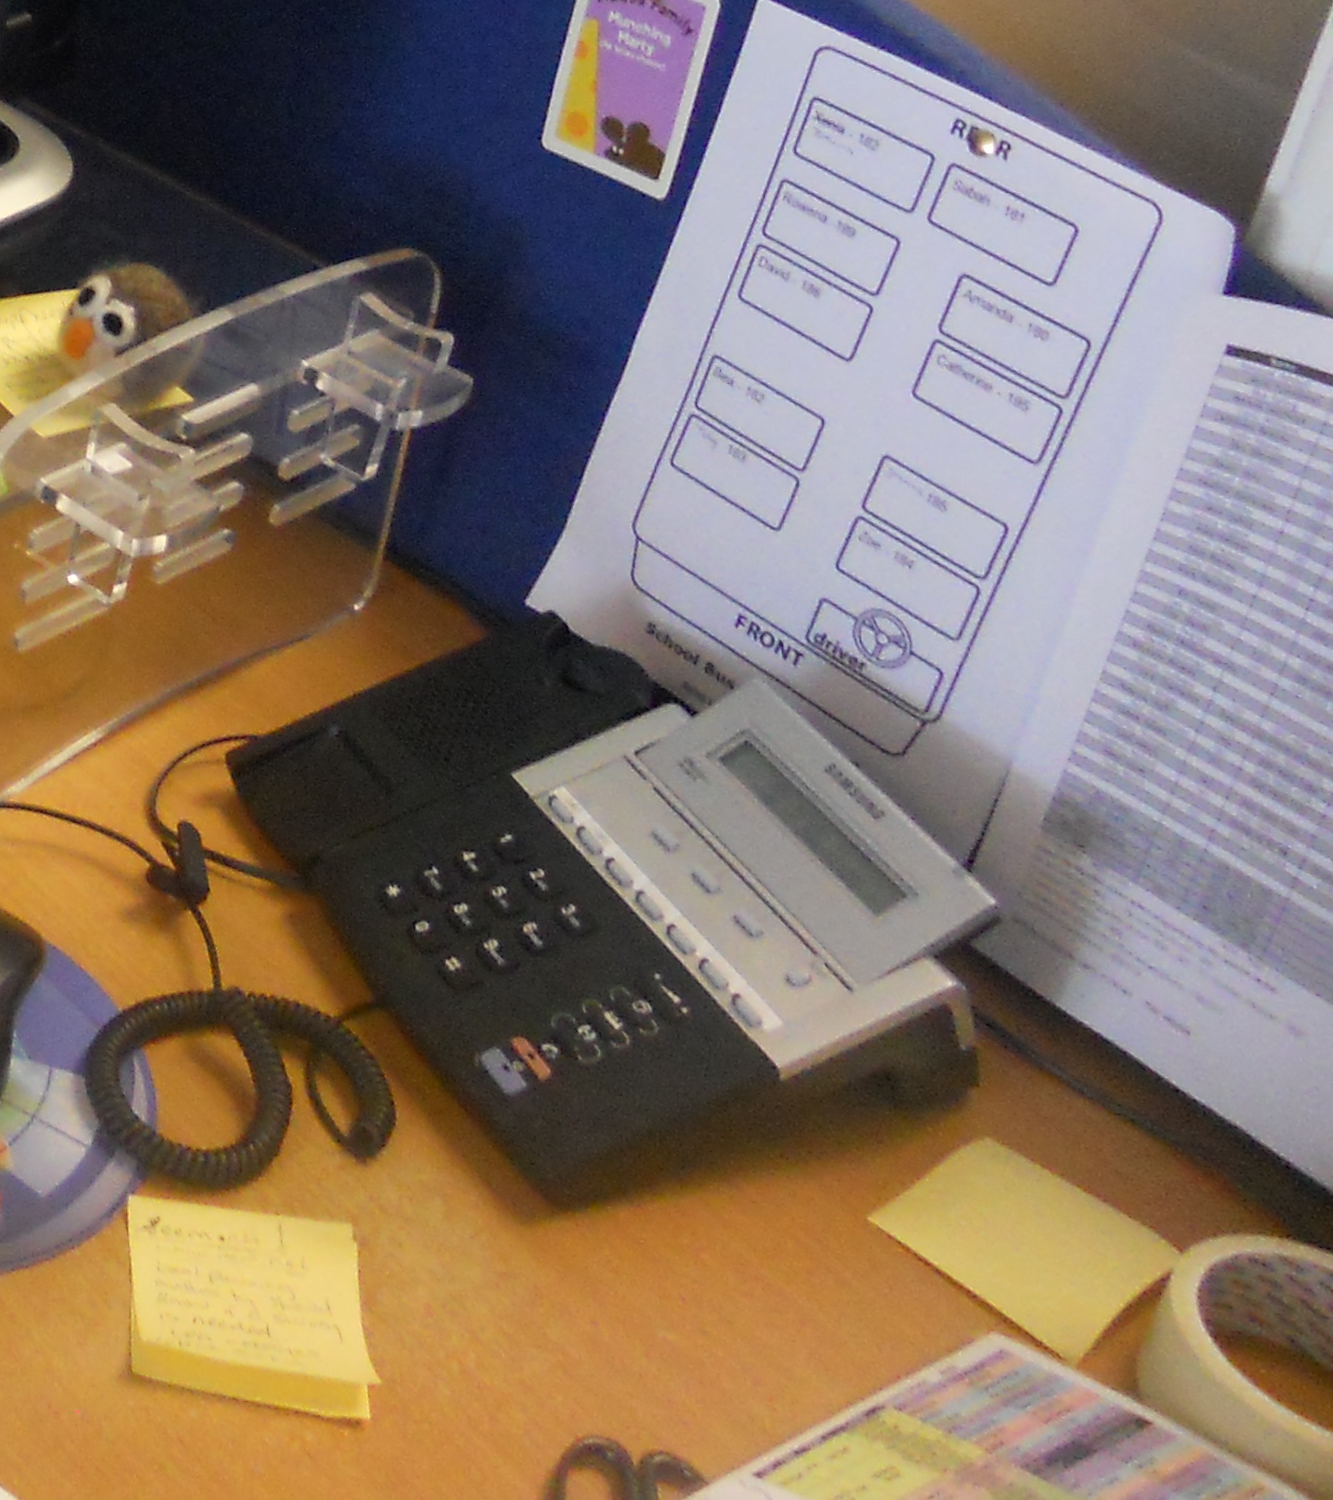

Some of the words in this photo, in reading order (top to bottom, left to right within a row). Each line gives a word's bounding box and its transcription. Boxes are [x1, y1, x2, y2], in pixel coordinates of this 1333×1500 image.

[608, 11, 672, 48] Munching
[963, 288, 1015, 325] Amanda
[645, 621, 699, 667] School
[704, 660, 736, 690] Bus
[734, 612, 805, 668] FRONT
[812, 631, 867, 673] driver
